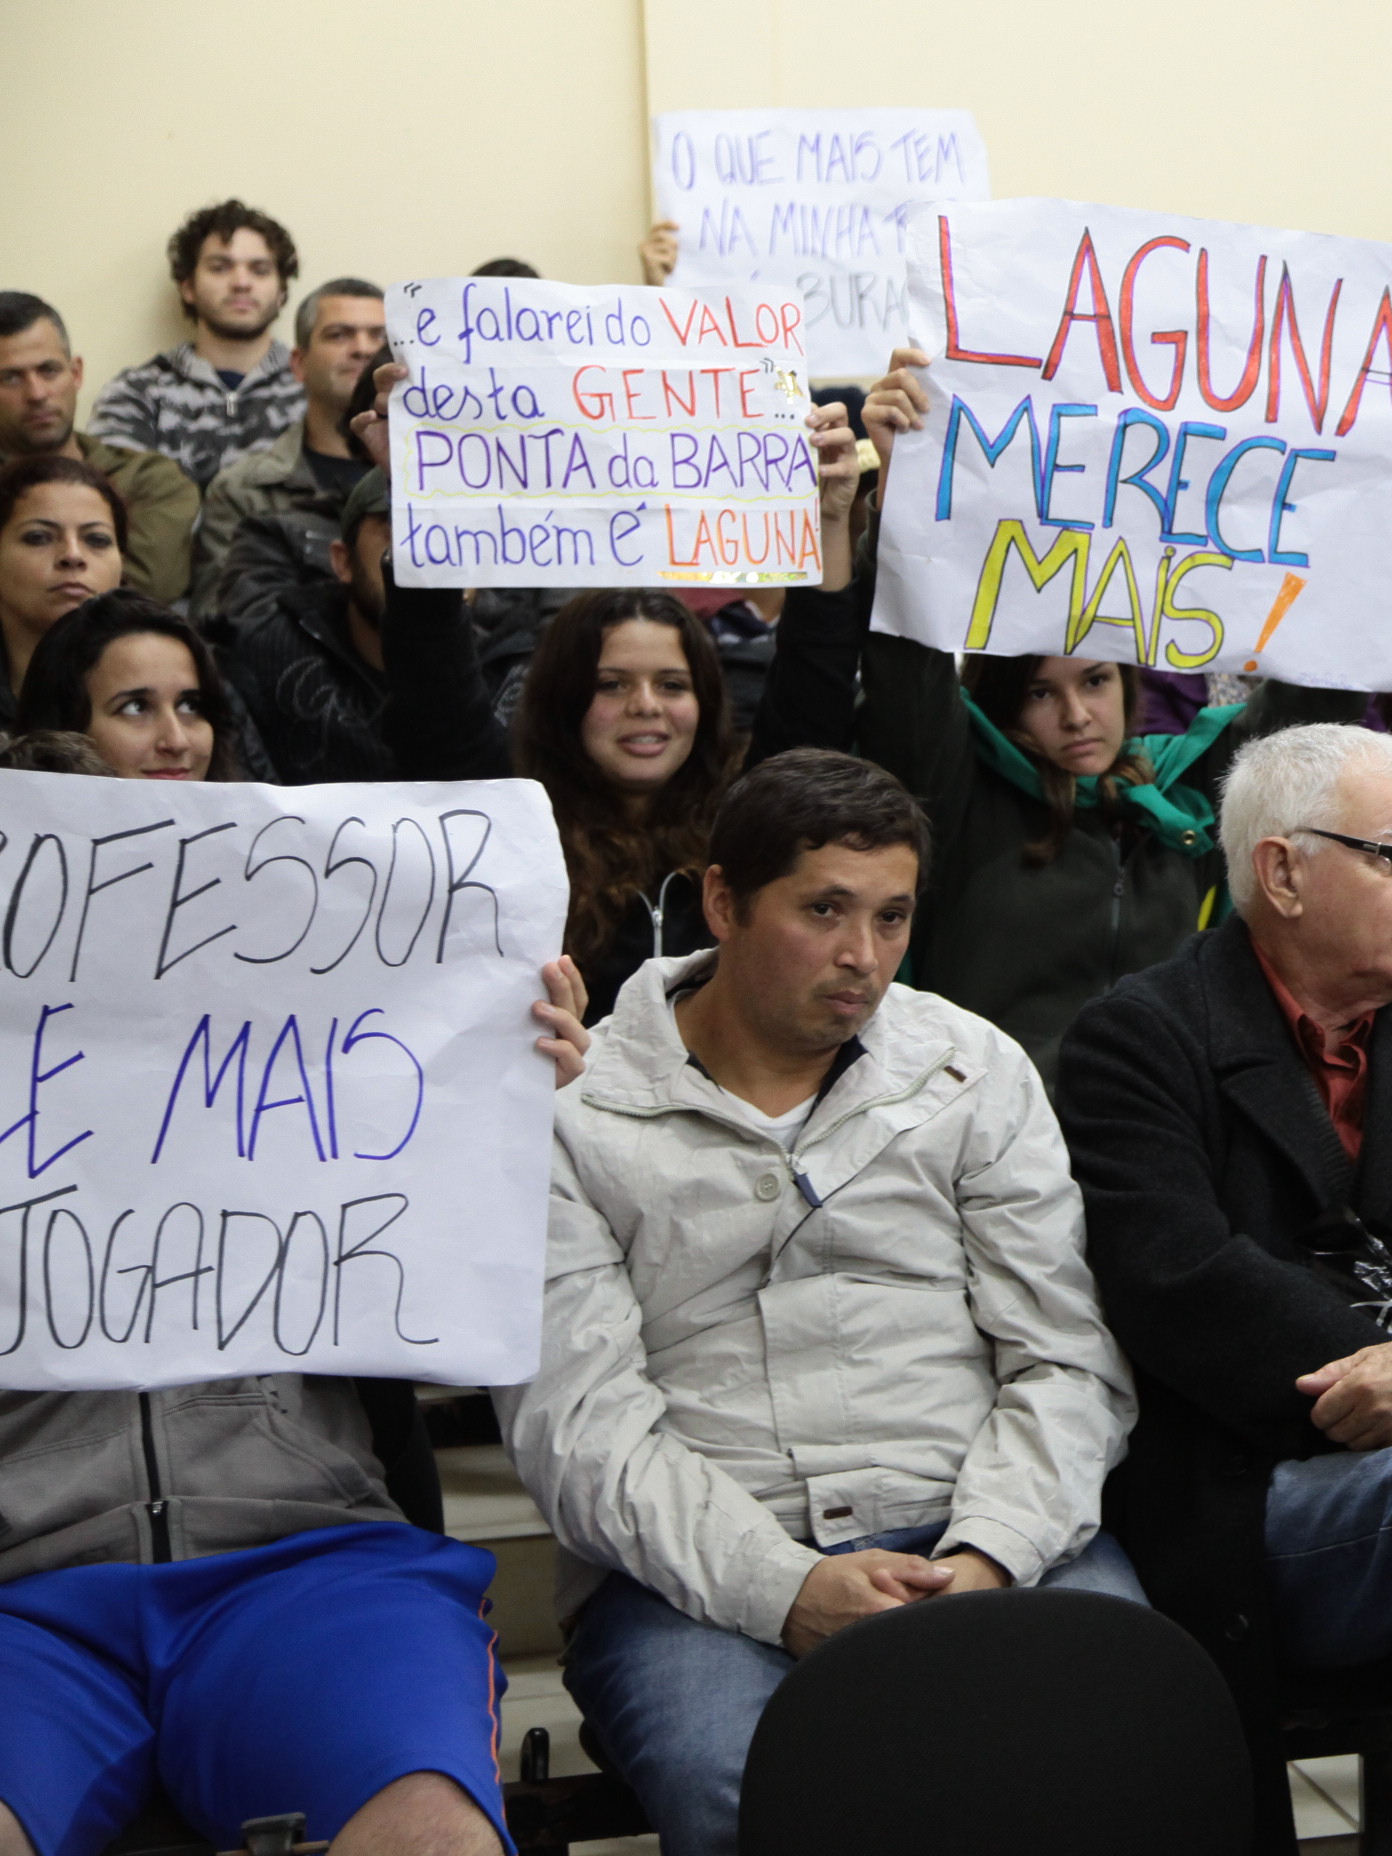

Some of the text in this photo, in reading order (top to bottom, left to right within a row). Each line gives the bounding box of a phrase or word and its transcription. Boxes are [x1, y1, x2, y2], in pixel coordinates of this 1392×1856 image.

[671, 126, 967, 191] O QUE MAIS TEM
[698, 197, 759, 260] NA
[768, 200, 881, 259] MINHA
[457, 283, 594, 364] falarei
[605, 297, 652, 347] do
[658, 295, 805, 356] VALOR
[402, 366, 545, 422] desta
[415, 427, 819, 493] PONTA da BARRA
[934, 393, 1337, 569] MERECE
[400, 501, 596, 569] também
[0, 808, 504, 983] OFESSOR
[151, 1007, 424, 1165] MAIS
[0, 1183, 440, 1357] JOGADOR
